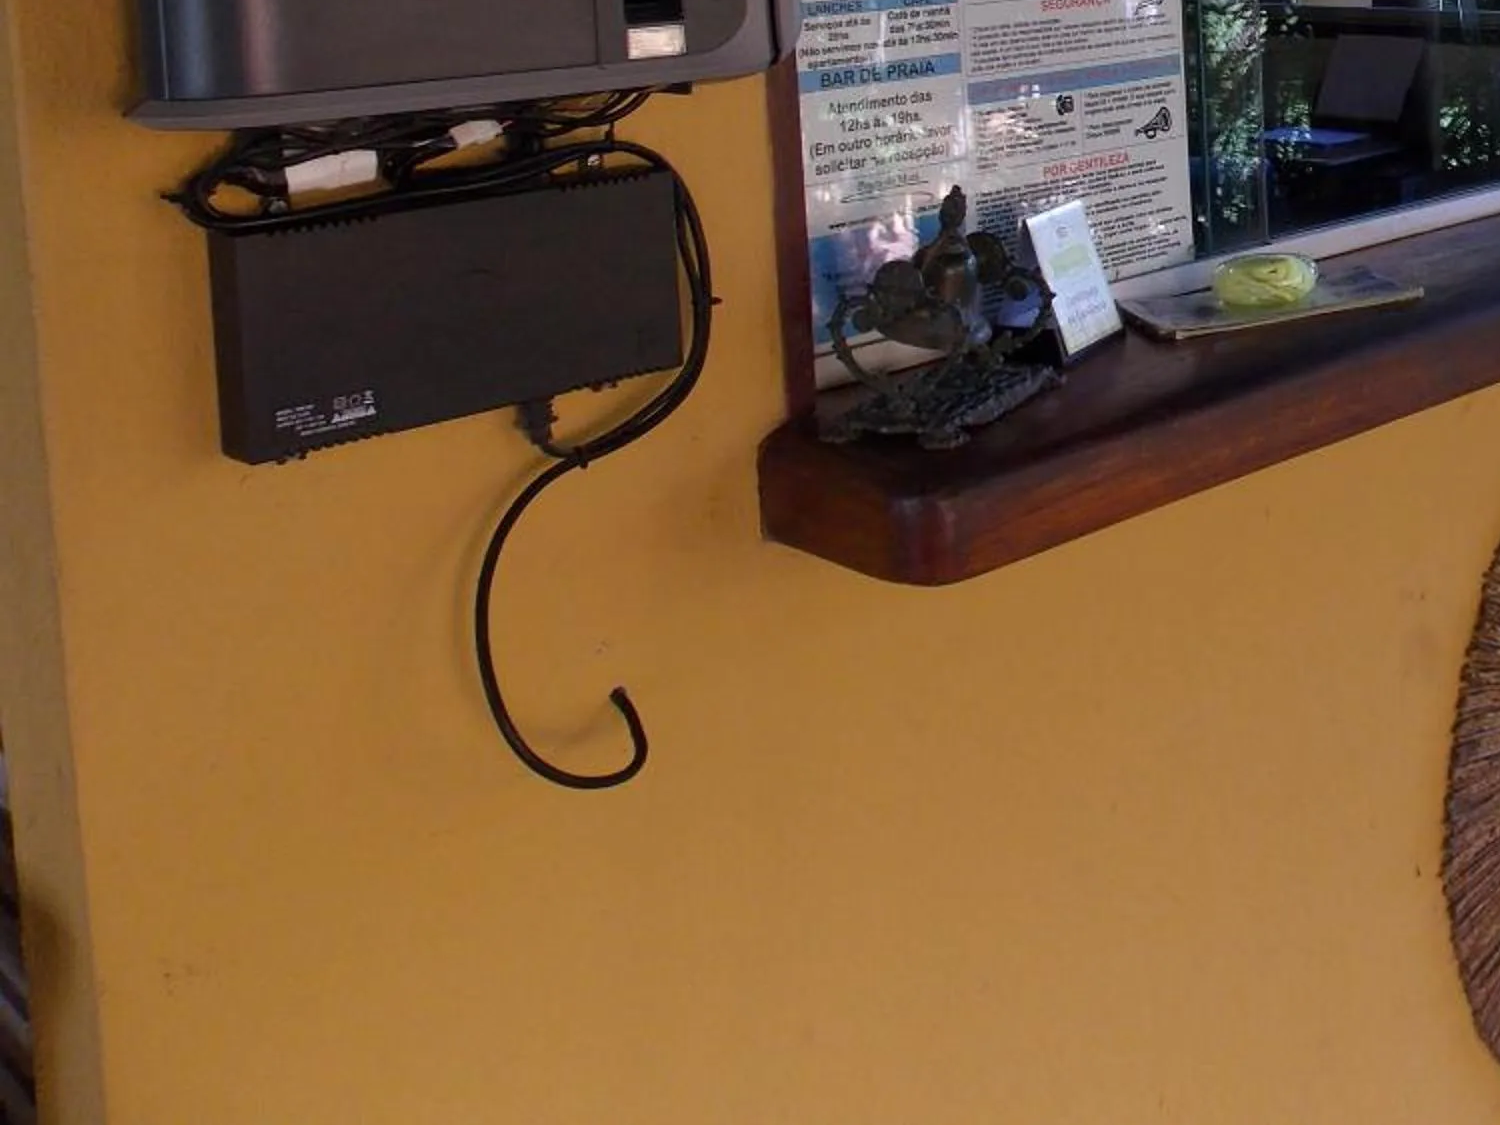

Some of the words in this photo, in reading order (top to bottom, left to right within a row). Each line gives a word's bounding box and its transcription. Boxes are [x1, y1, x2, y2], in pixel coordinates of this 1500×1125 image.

[820, 71, 855, 88] BAR
[859, 66, 882, 83] DE
[887, 60, 936, 81] PRAIA
[829, 93, 908, 115] Atendimento
[909, 89, 933, 103] das
[840, 118, 871, 133] 12hs
[810, 141, 835, 160] (Em
[838, 136, 873, 153] outro
[1043, 162, 1067, 178] POR
